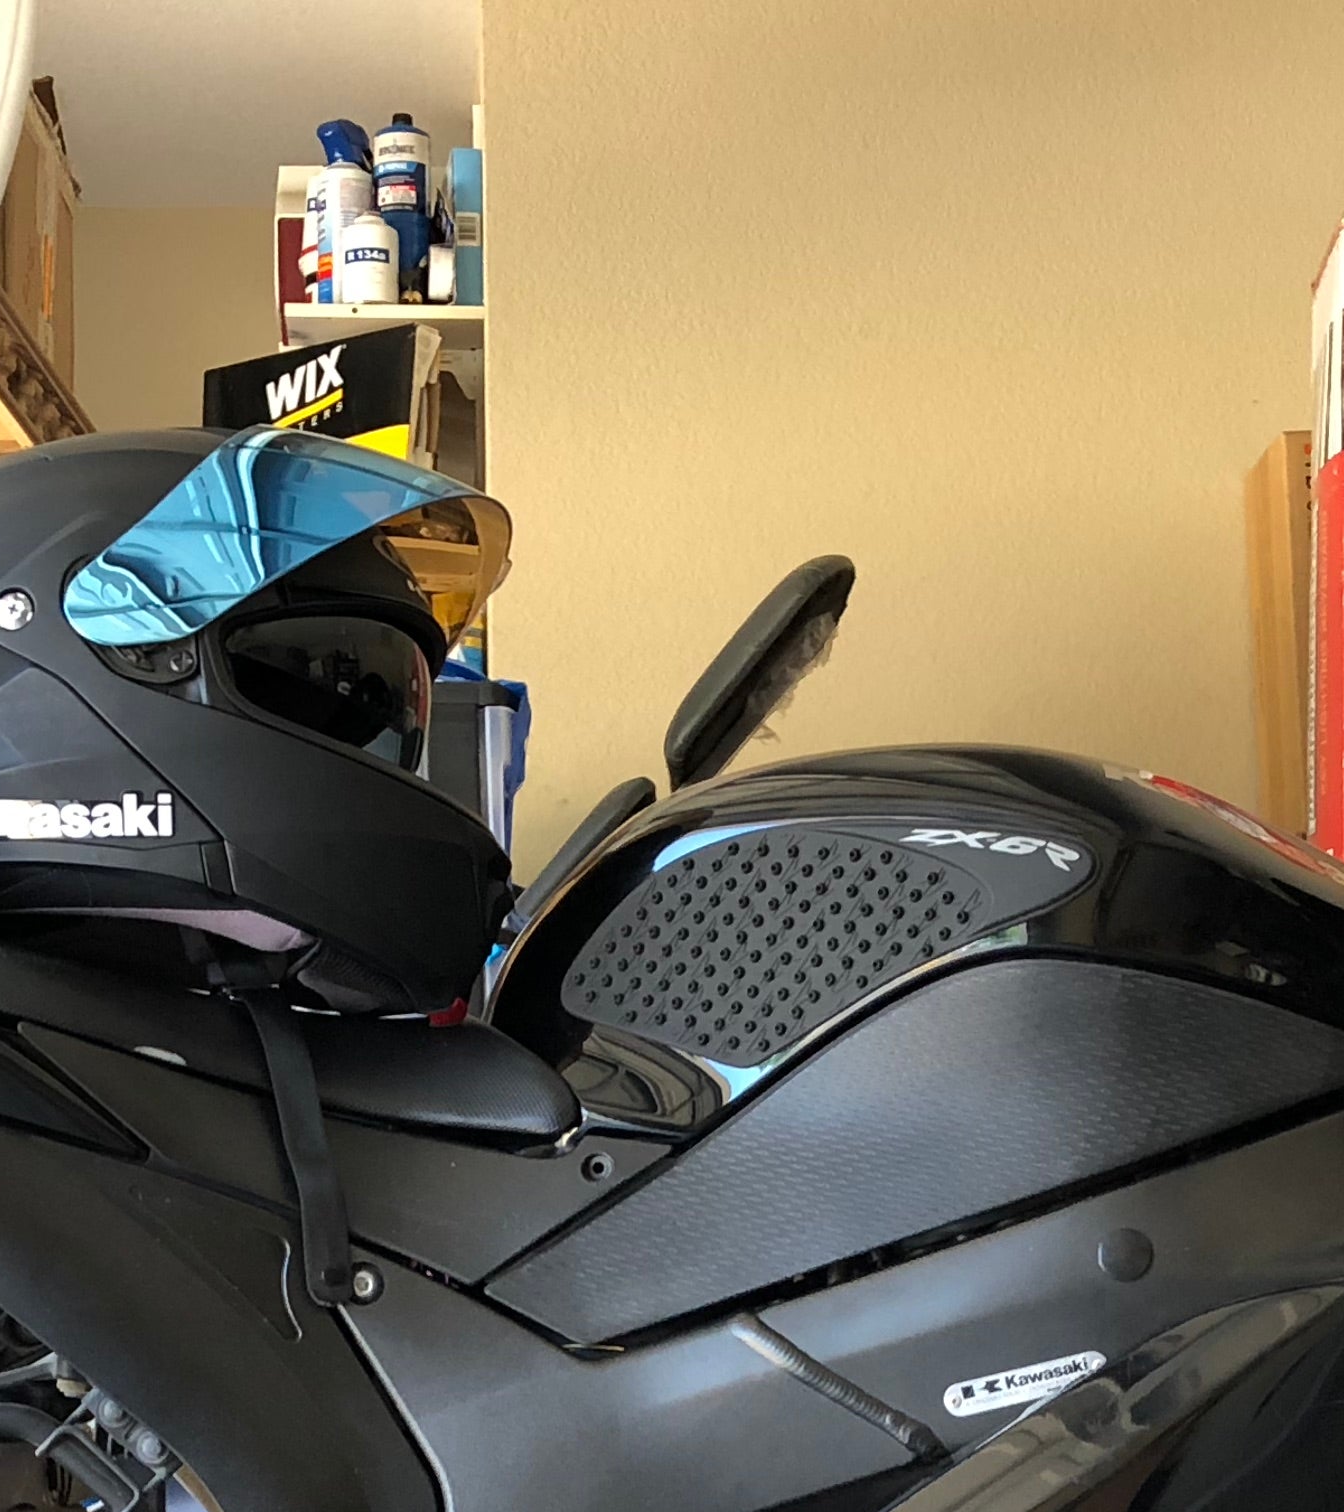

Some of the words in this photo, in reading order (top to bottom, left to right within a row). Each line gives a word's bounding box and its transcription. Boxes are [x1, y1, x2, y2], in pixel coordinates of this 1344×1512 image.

[266, 345, 343, 420] WIX
[298, 402, 343, 431] TERS
[901, 826, 1081, 871] ZX-6R
[1005, 1357, 1089, 1390] Kawasaki
